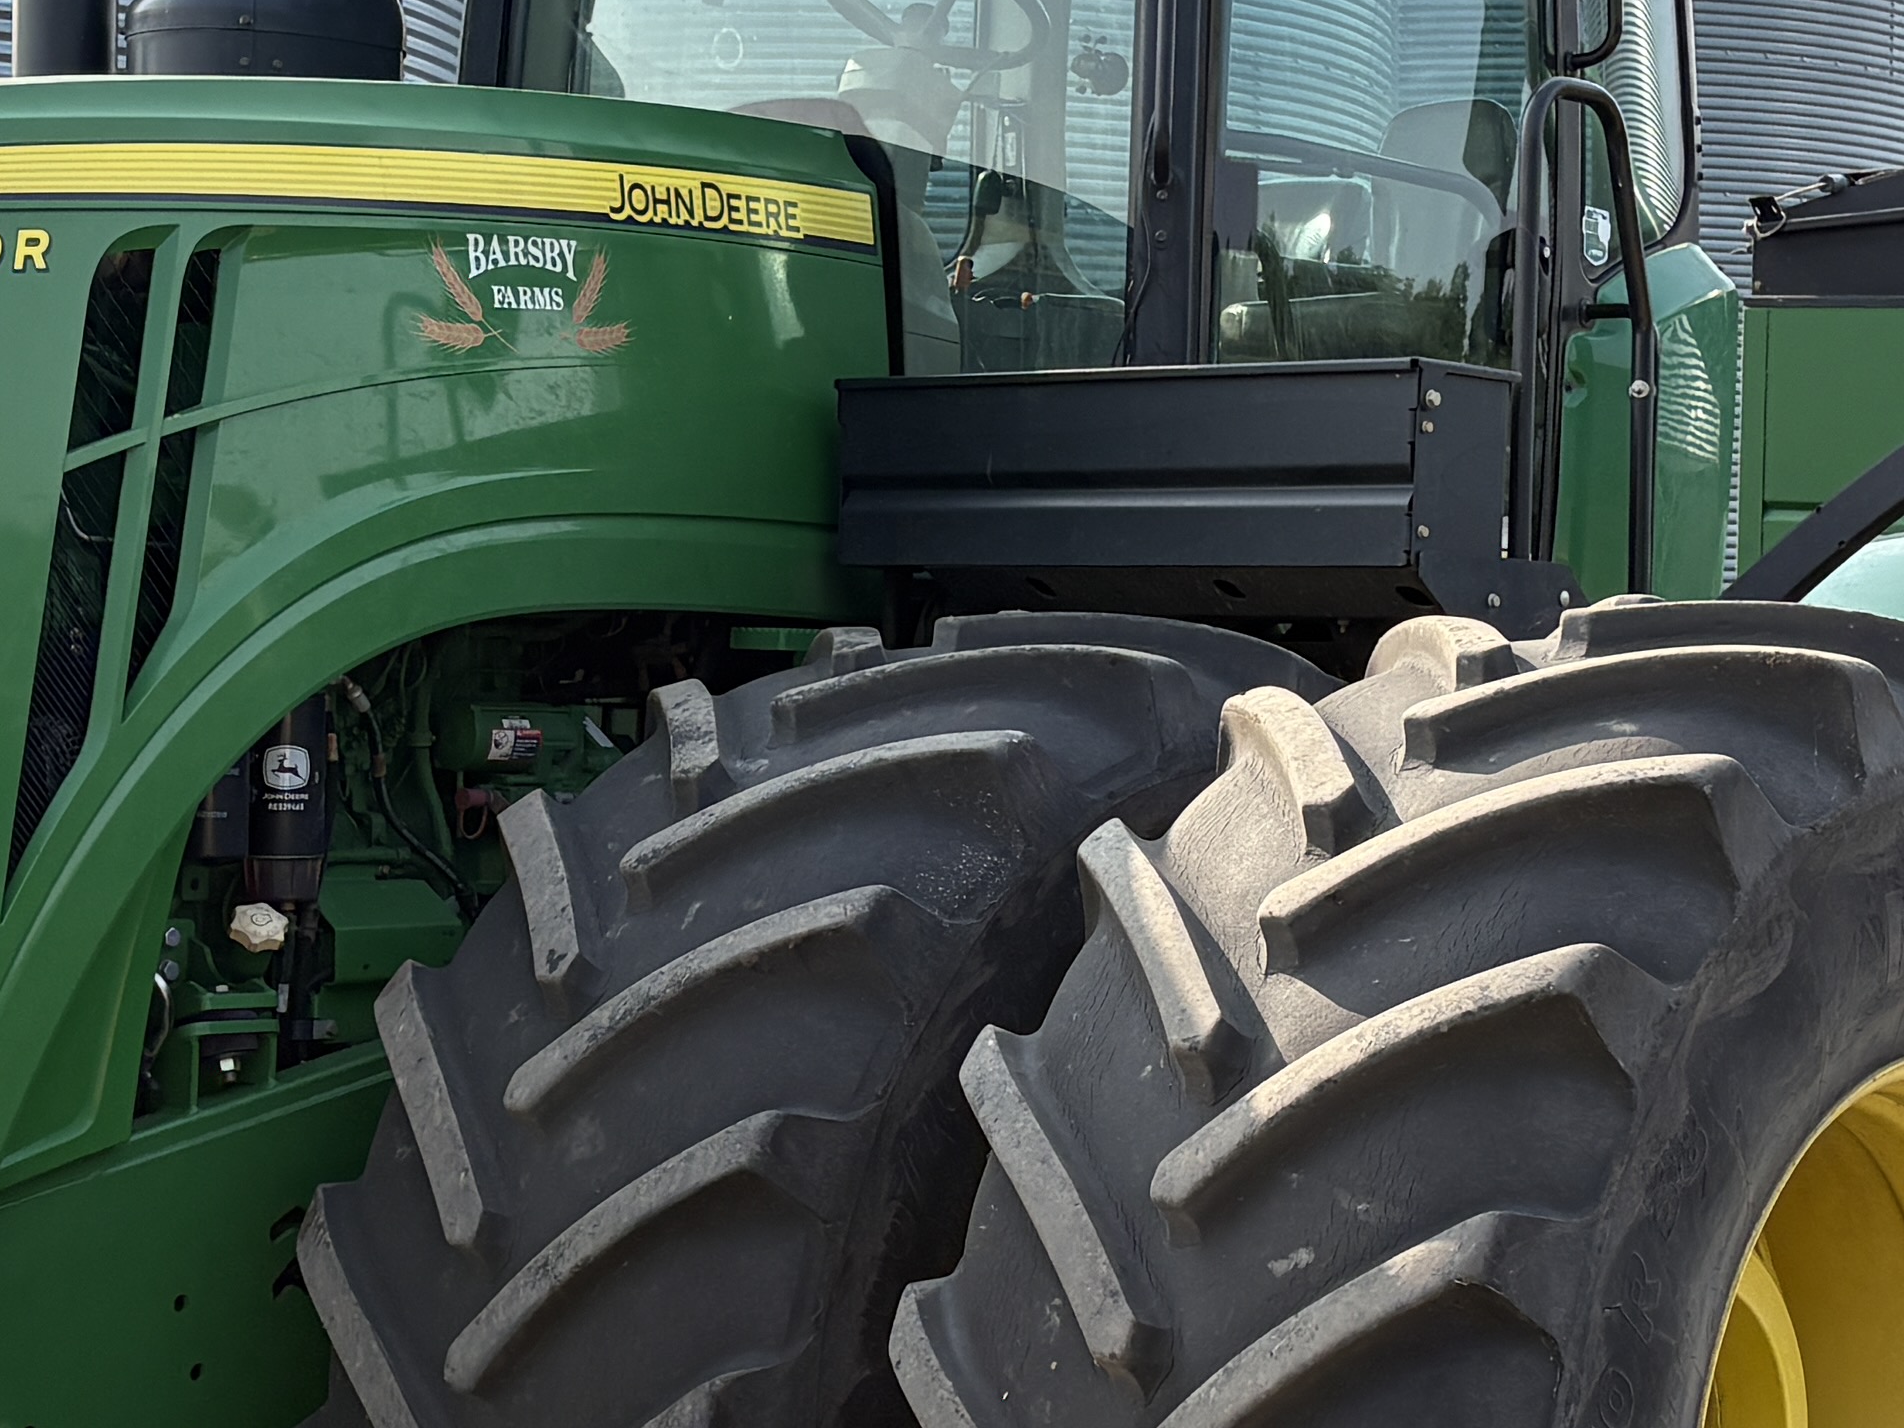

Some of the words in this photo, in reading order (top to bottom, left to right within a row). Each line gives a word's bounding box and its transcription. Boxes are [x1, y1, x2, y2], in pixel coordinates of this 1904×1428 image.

[608, 172, 696, 222] JOHN
[699, 180, 802, 236] DEERE
[12, 228, 51, 271] R
[466, 232, 577, 282] BARSBY
[491, 284, 565, 311] FARMS
